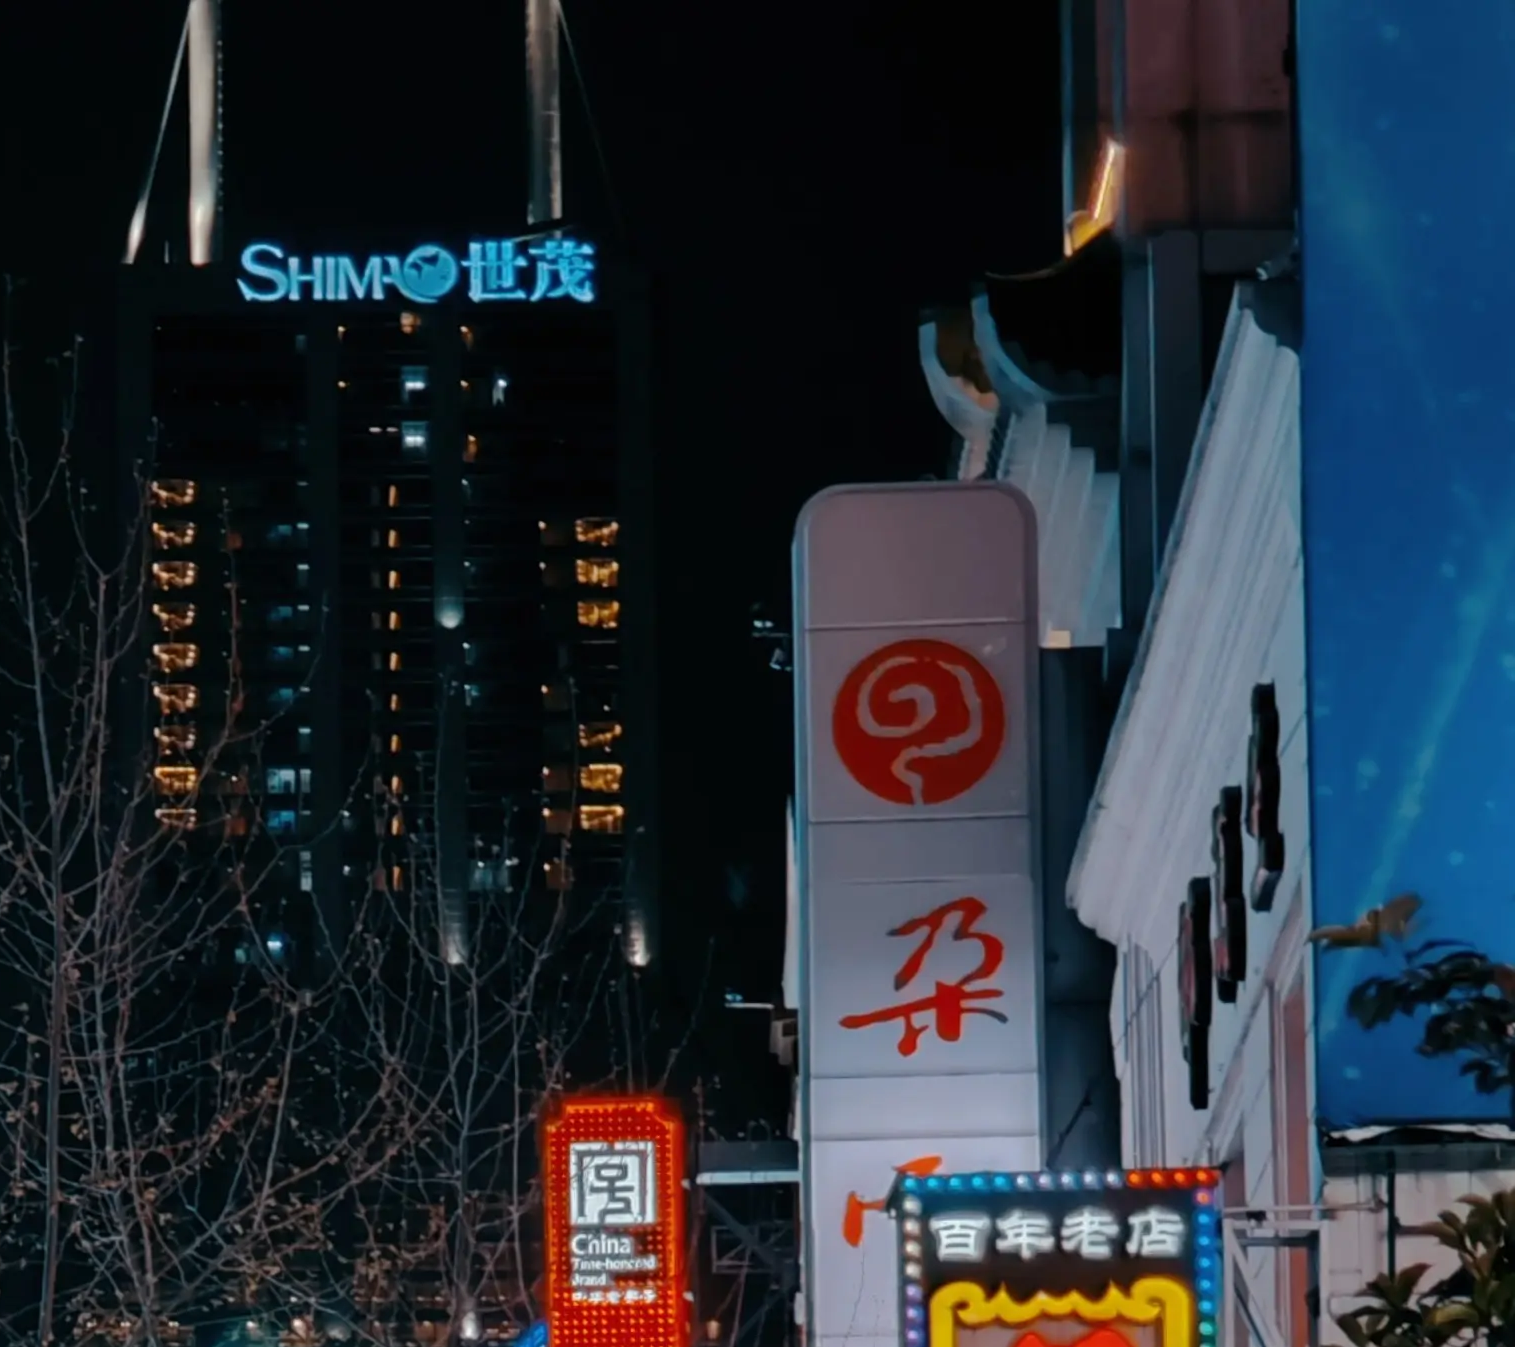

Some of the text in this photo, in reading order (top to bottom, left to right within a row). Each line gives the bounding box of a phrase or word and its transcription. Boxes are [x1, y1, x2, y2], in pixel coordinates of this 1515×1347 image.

[460, 240, 595, 302] 世茂
[571, 1233, 630, 1254] China
[929, 1208, 1186, 1260] 百年老店
